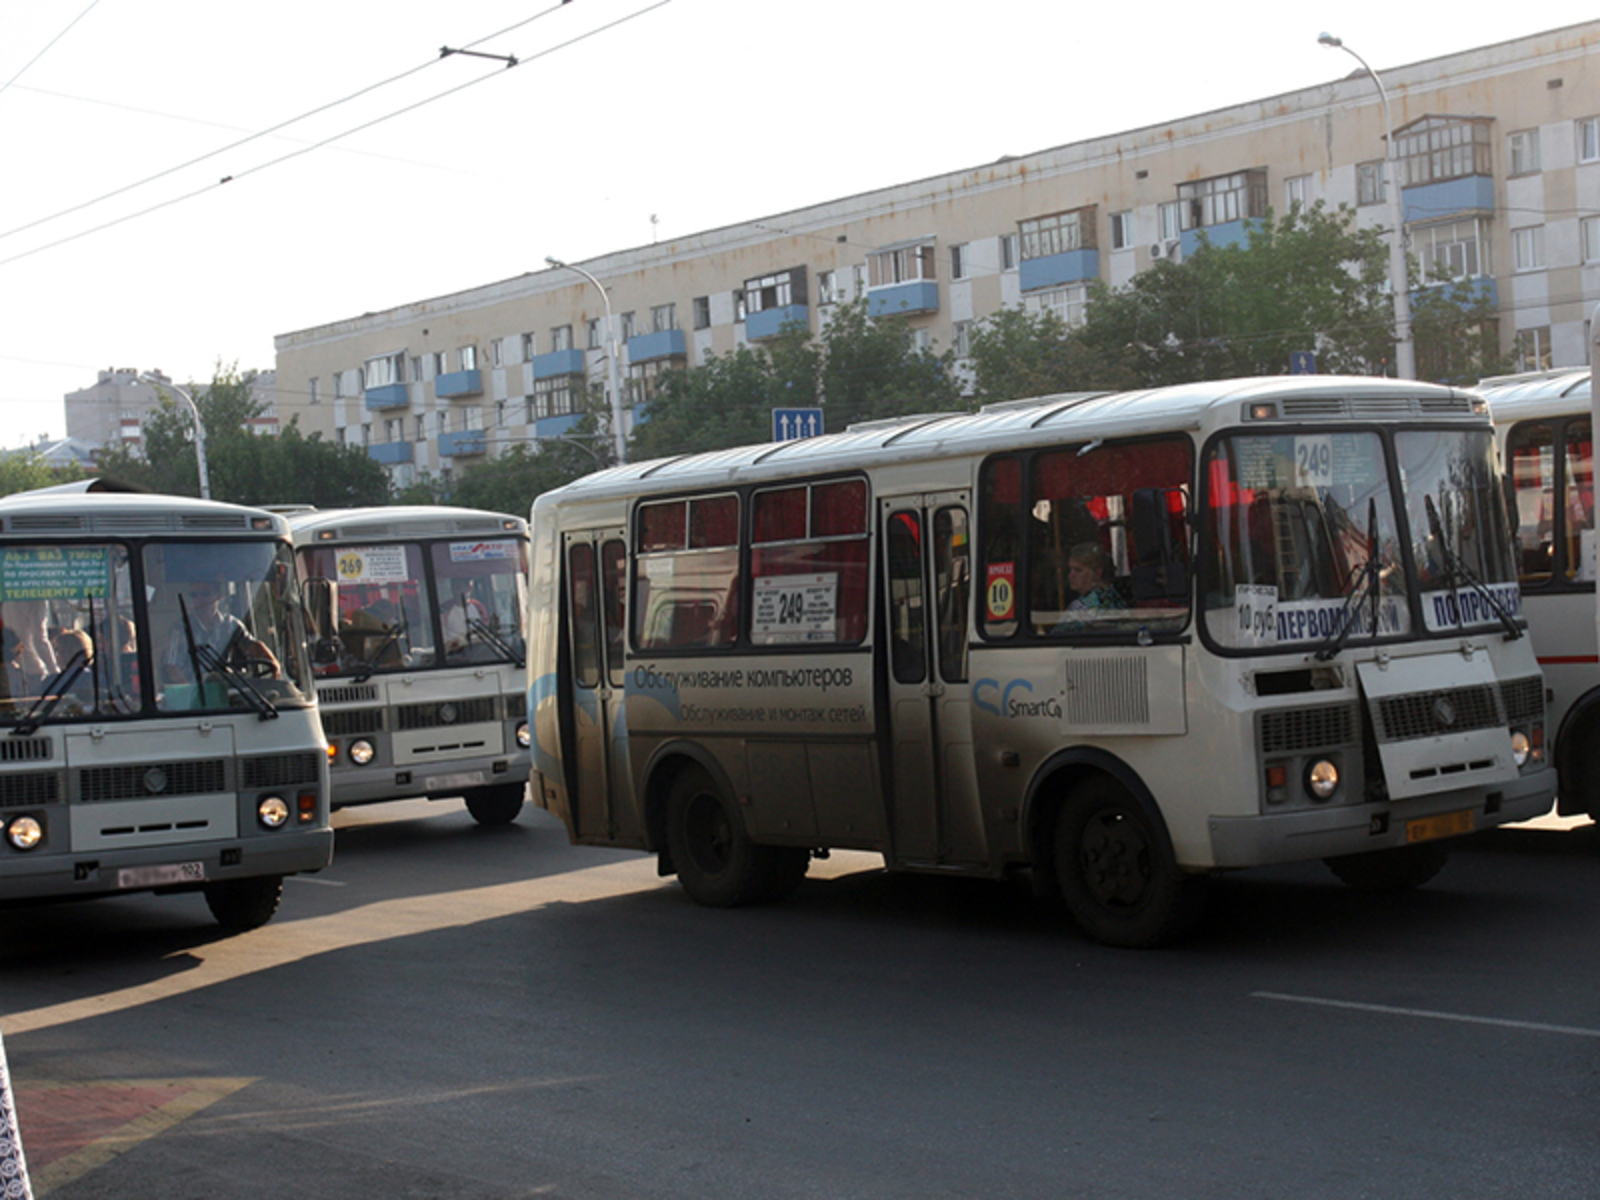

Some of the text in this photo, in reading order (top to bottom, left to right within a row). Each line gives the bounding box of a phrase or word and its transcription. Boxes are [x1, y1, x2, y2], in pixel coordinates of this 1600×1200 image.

[1297, 443, 1331, 477] 249
[340, 558, 363, 575] 269
[992, 583, 1009, 603] 10
[779, 592, 803, 625] 249
[1239, 604, 1252, 630] 10
[1433, 594, 1458, 627] ПО
[634, 664, 853, 694] Обслуживание компьютеров
[679, 704, 867, 724] Обслуживание и монтаж сетей
